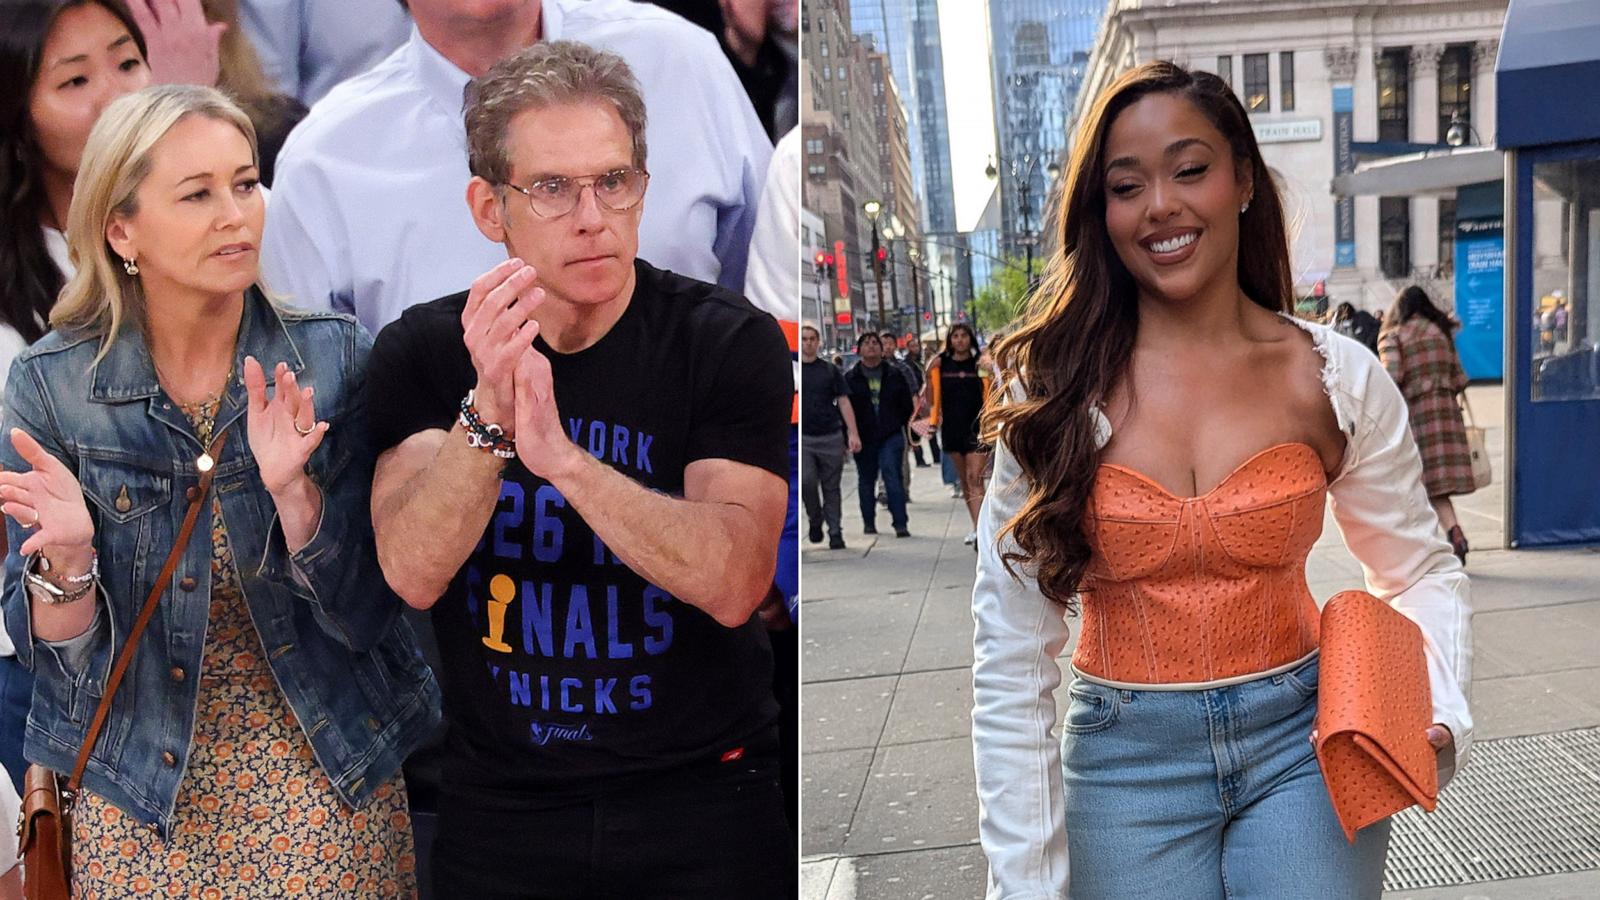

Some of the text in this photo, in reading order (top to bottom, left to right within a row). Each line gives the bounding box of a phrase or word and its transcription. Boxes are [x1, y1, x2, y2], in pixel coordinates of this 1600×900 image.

[569, 417, 653, 474] YORK
[475, 479, 565, 563] 26
[487, 661, 653, 714] NICKS
